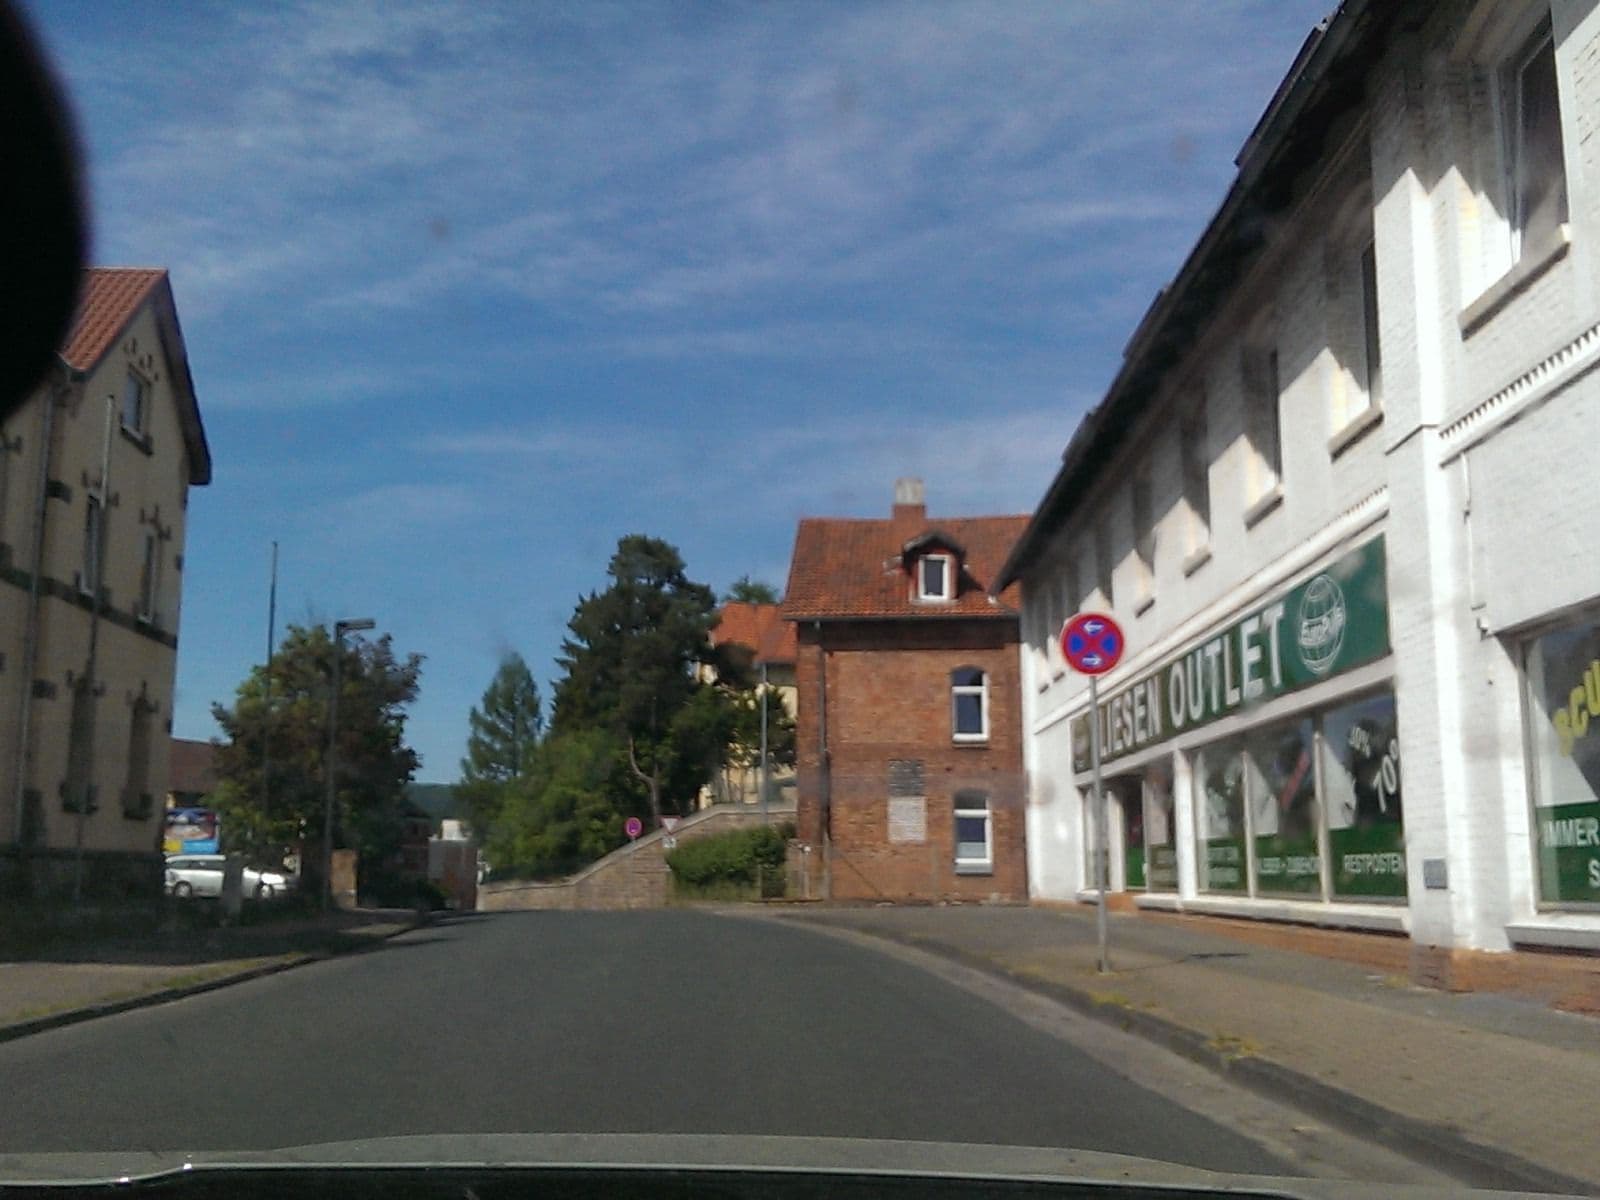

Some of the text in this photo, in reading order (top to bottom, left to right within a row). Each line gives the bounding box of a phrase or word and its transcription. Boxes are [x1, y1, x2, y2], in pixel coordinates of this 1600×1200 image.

[1096, 602, 1284, 757] LIESEN OUTLET
[1543, 817, 1600, 848] IMMER
